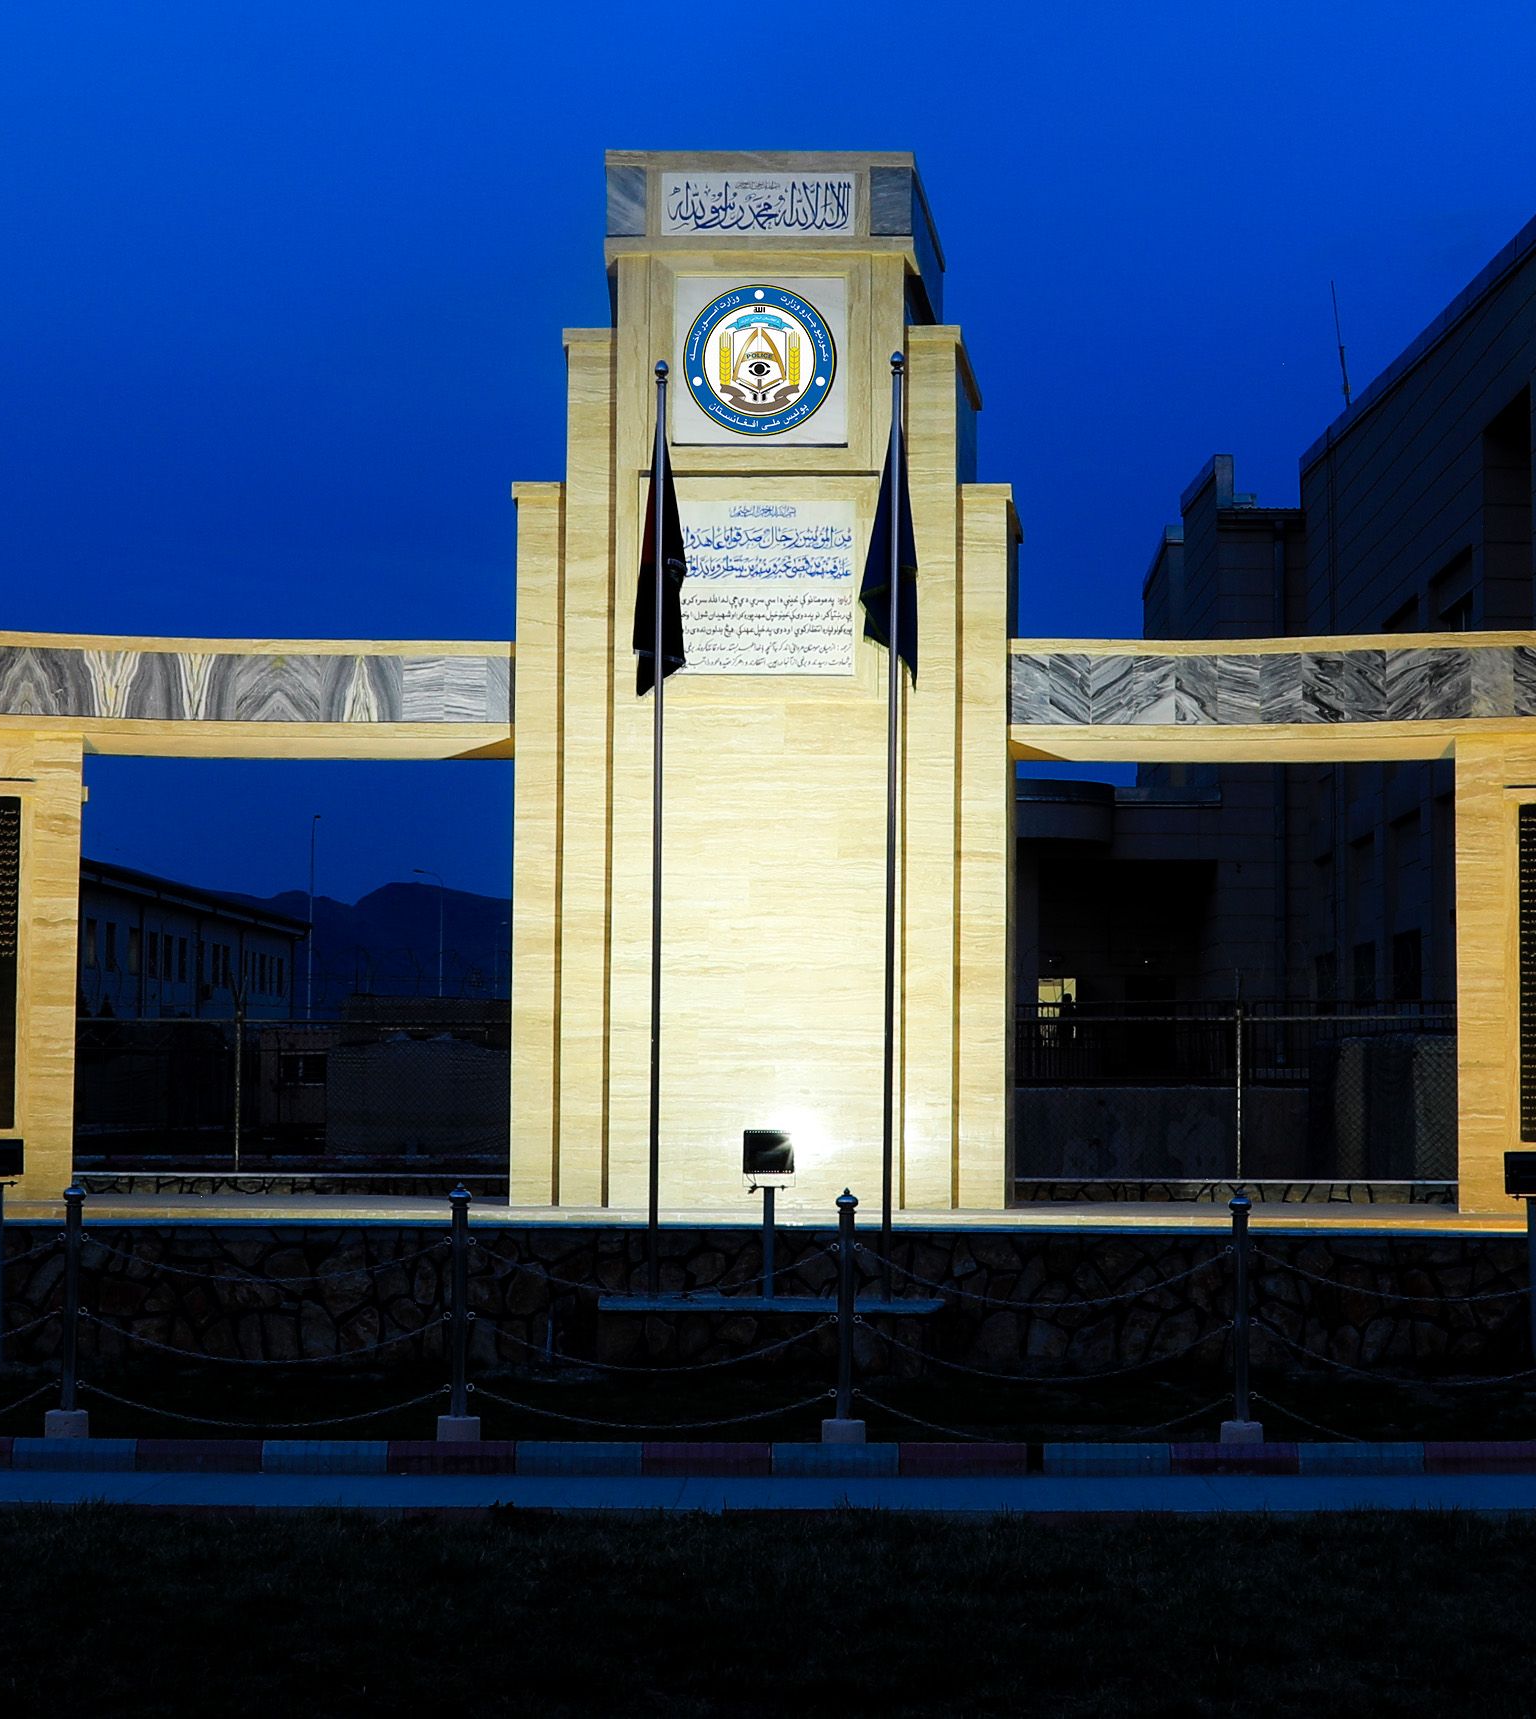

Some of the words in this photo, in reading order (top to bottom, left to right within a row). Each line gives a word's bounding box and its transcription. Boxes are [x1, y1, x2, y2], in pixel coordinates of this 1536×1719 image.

[719, 296, 740, 308] وزارت
[780, 296, 801, 311] وزارت
[701, 305, 720, 331] امور
[708, 403, 760, 428] افغانستان
[784, 404, 810, 424] پولیس
